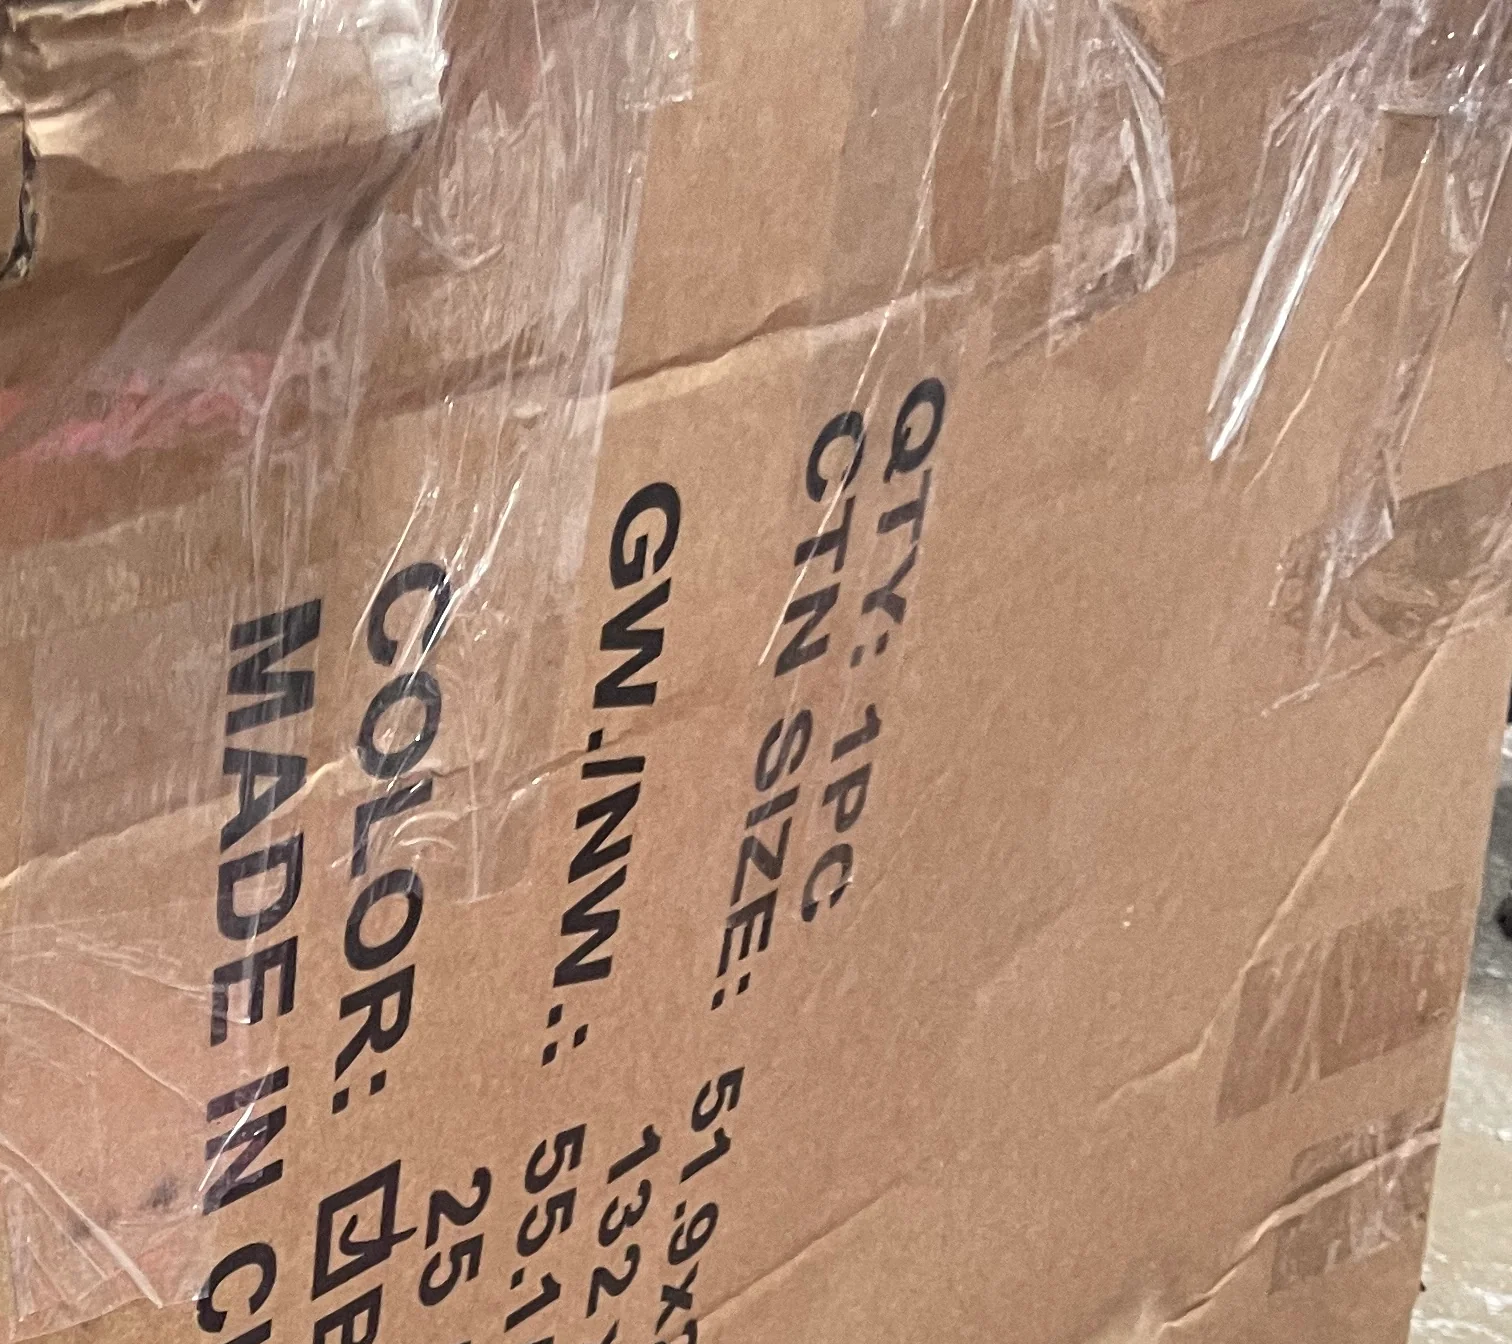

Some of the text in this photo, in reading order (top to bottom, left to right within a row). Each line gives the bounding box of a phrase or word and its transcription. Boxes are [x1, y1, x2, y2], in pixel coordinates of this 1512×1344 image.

[772, 410, 868, 678] CTN
[799, 378, 947, 923] QTY: 1PC
[209, 598, 322, 1047] MADE
[331, 560, 454, 1115] COLOR:
[710, 708, 812, 1012] SIZE:
[203, 1065, 290, 1217] IN
[417, 1166, 494, 1307] 25
